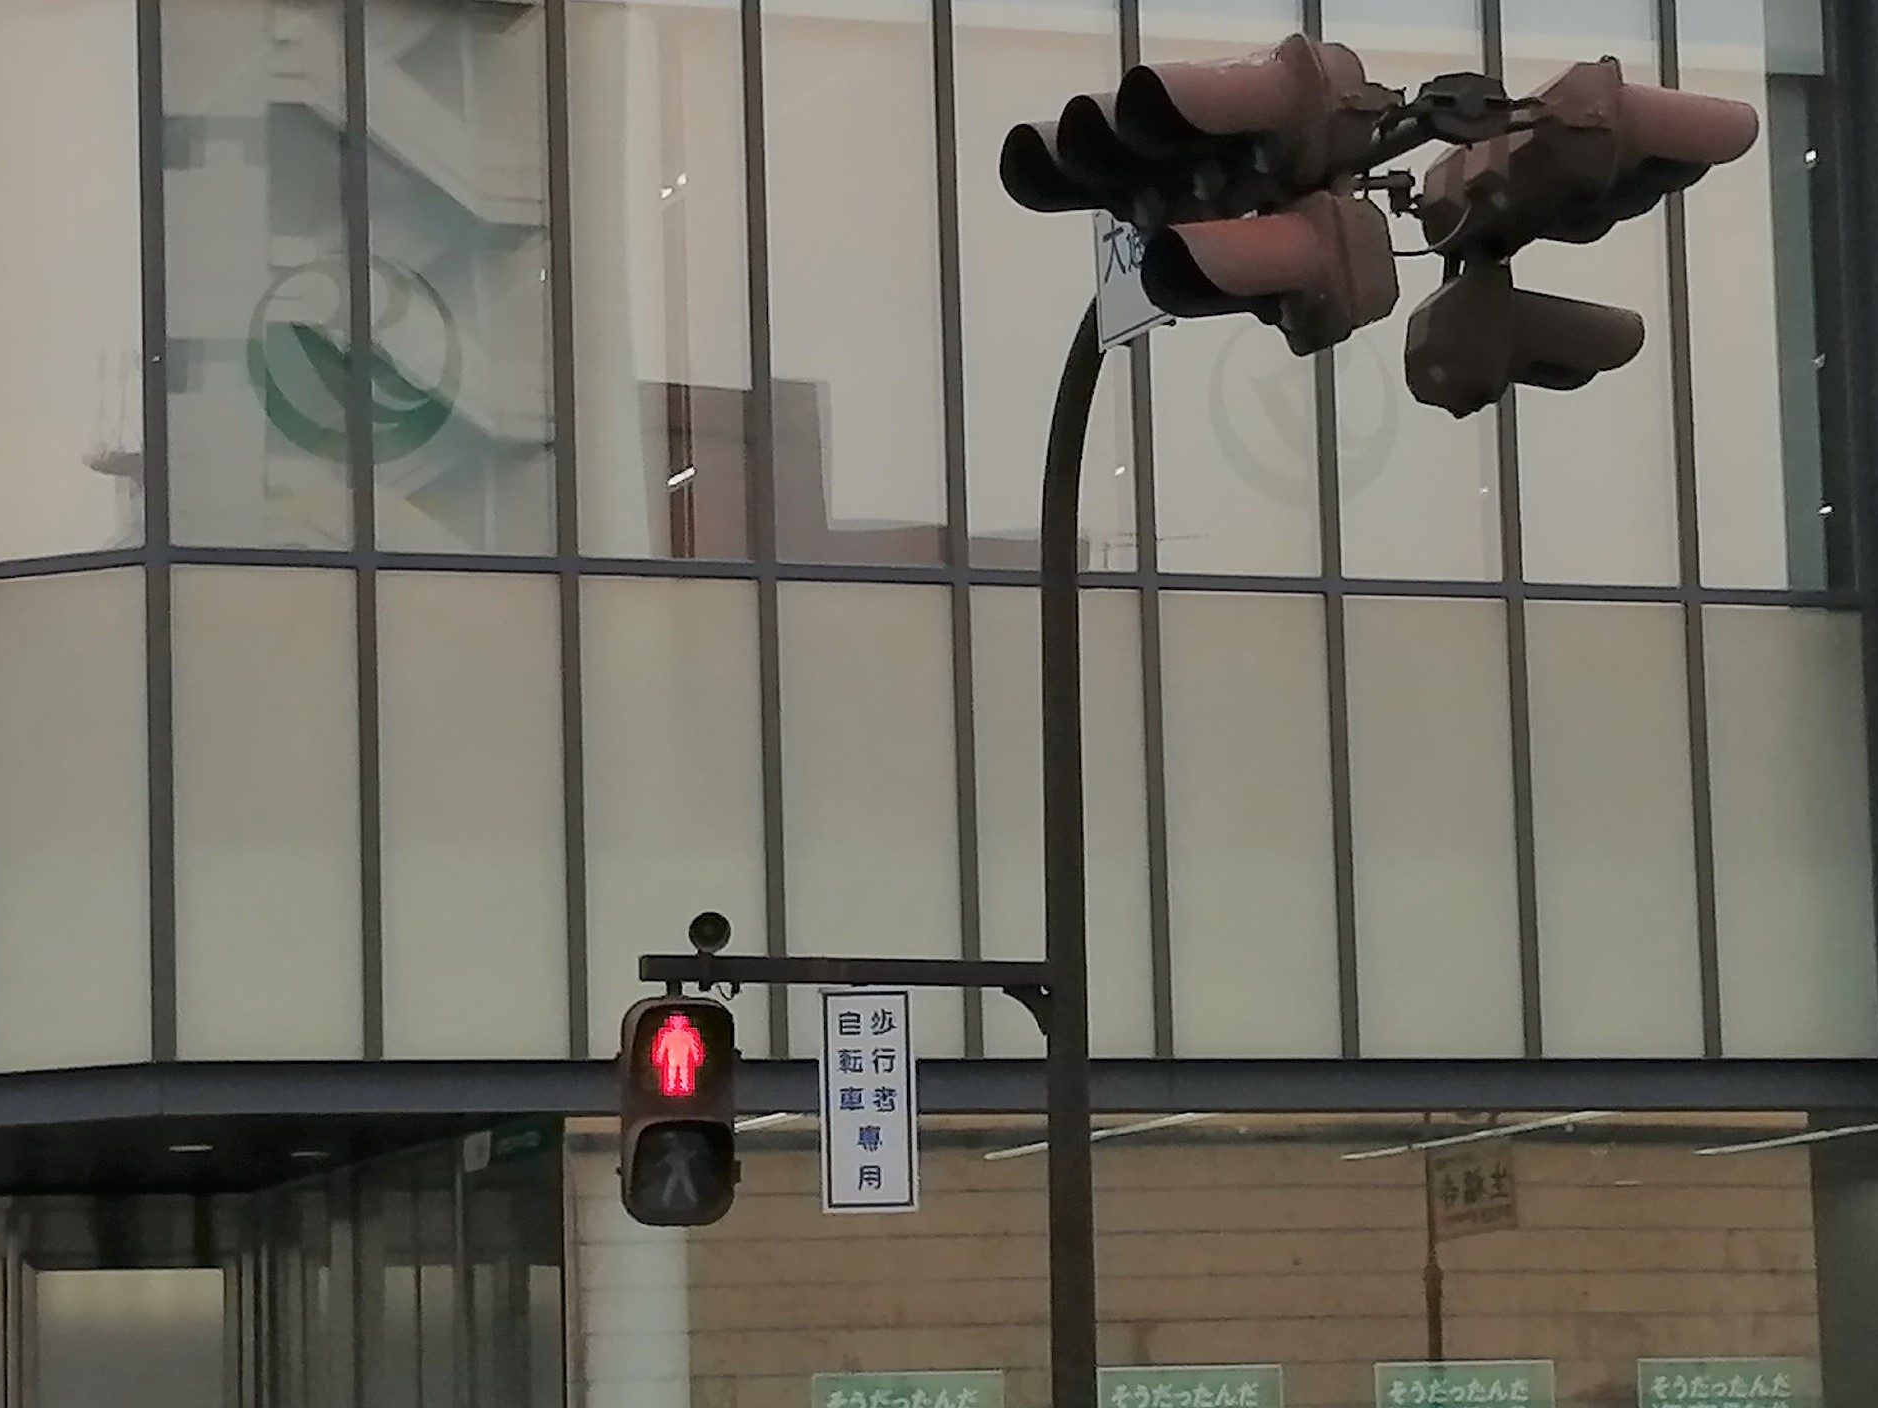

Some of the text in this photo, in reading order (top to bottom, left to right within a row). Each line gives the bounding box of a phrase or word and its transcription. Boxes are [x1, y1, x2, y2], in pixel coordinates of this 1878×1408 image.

[836, 1009, 866, 1113] 自転車
[870, 1007, 898, 1113] 歩行者
[1388, 1377, 1530, 1404] そうだったんだ
[1650, 1372, 1792, 1400] そうだったんだ
